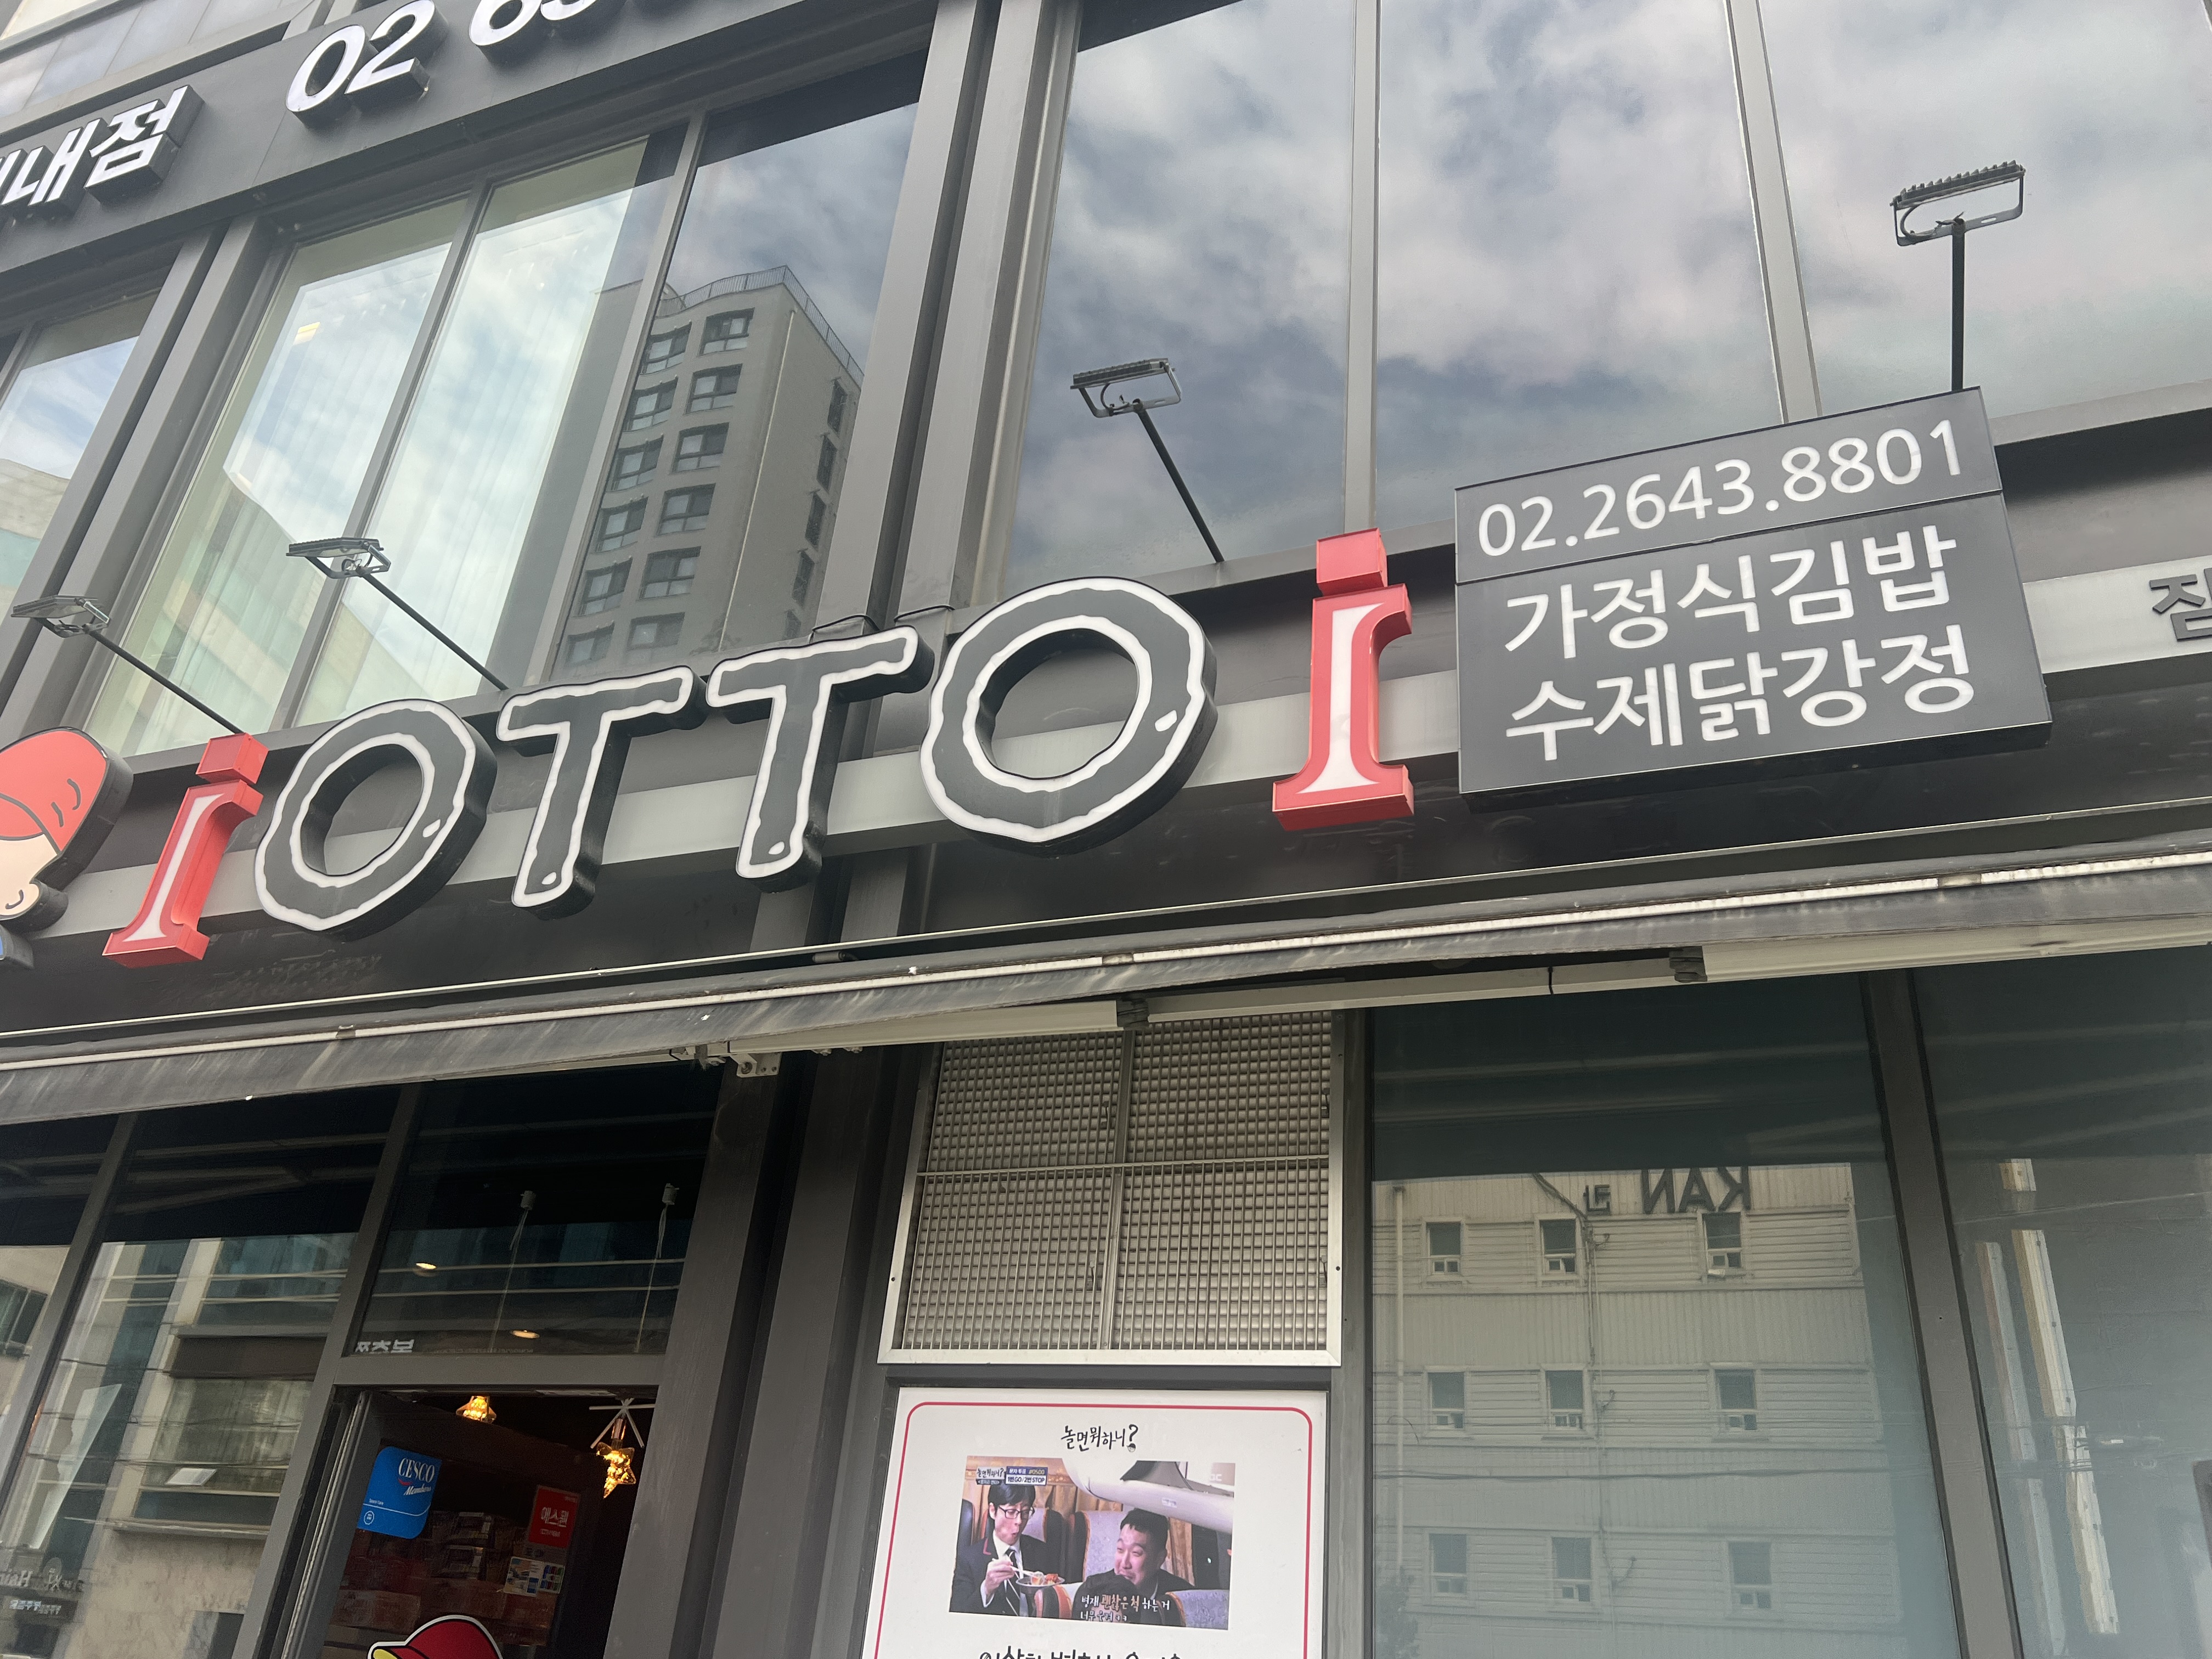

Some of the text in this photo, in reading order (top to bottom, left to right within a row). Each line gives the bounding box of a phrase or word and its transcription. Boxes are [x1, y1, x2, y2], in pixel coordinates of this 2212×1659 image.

[285, 0, 437, 112] 02
[0, 84, 188, 206] 내점
[1478, 419, 1962, 558] 02.2643.8801
[1504, 524, 1957, 659] 가정식김밥
[1505, 624, 1974, 761] 수제닭강정
[398, 1458, 435, 1483] CESCO
[1060, 1424, 1138, 1452] 놀면뭐하니?
[1080, 1610, 1096, 1621] 너무
[1097, 1610, 1114, 1622] 웃겨
[1081, 1594, 1170, 1612] 병재 괜찮은 척 하는 거
